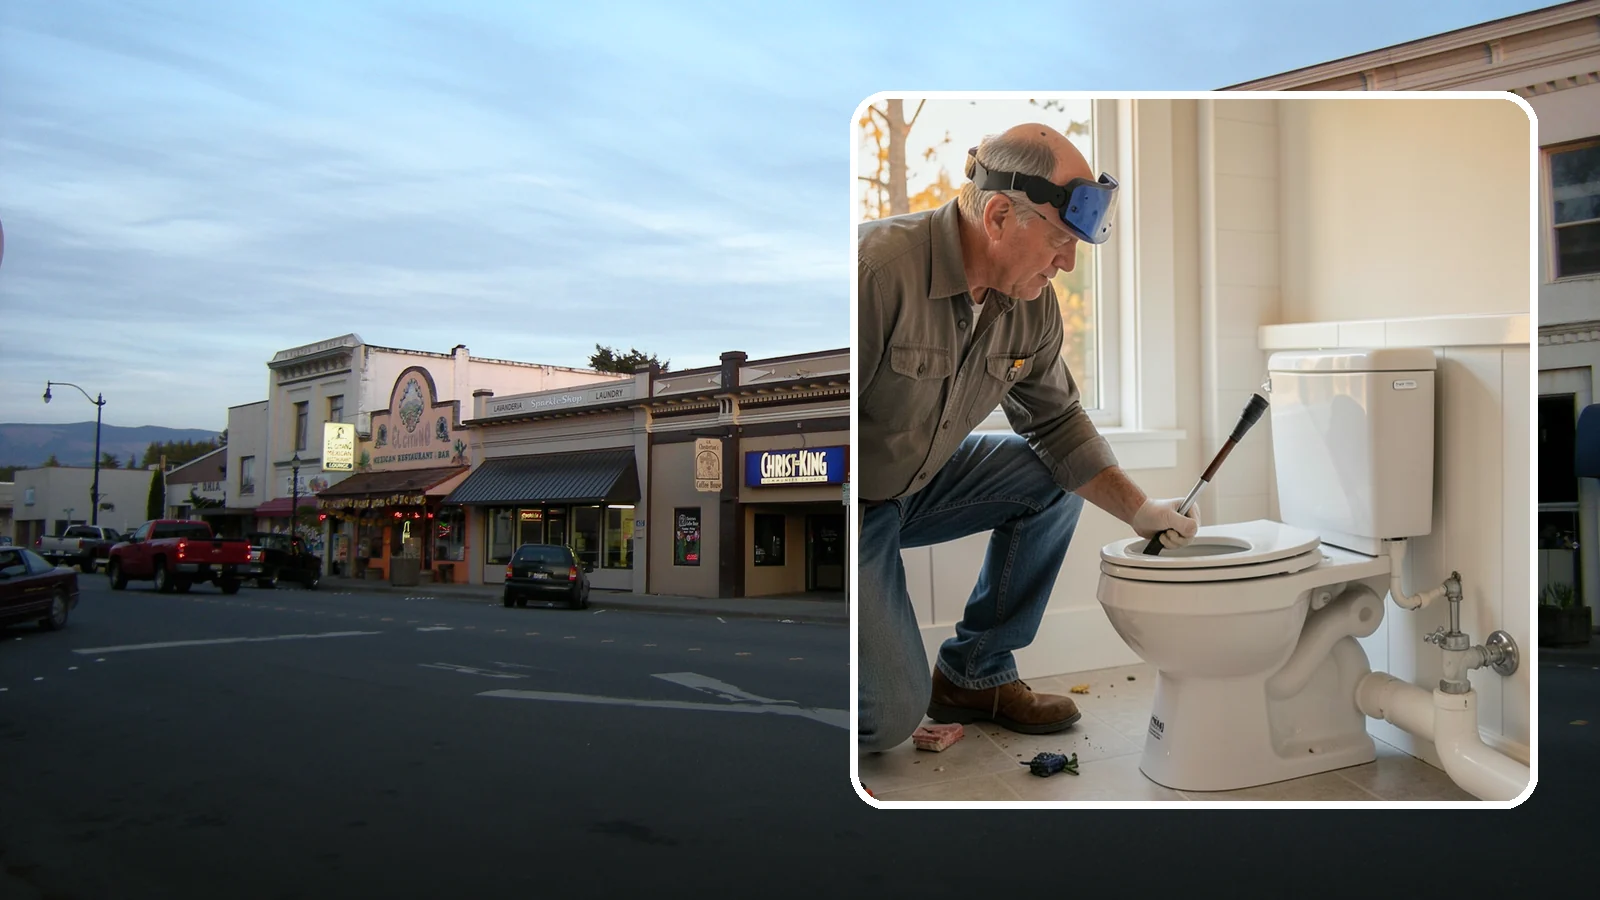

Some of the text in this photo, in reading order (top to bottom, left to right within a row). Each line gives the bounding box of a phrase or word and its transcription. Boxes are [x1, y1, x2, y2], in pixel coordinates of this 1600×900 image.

[562, 394, 583, 406] Shop
[595, 389, 624, 400] LAUNDRY
[494, 402, 523, 412] LAVANDERIA
[397, 451, 433, 462] RESTAURANT
[437, 450, 450, 459] BAR
[761, 450, 828, 478] CHRIST KING
